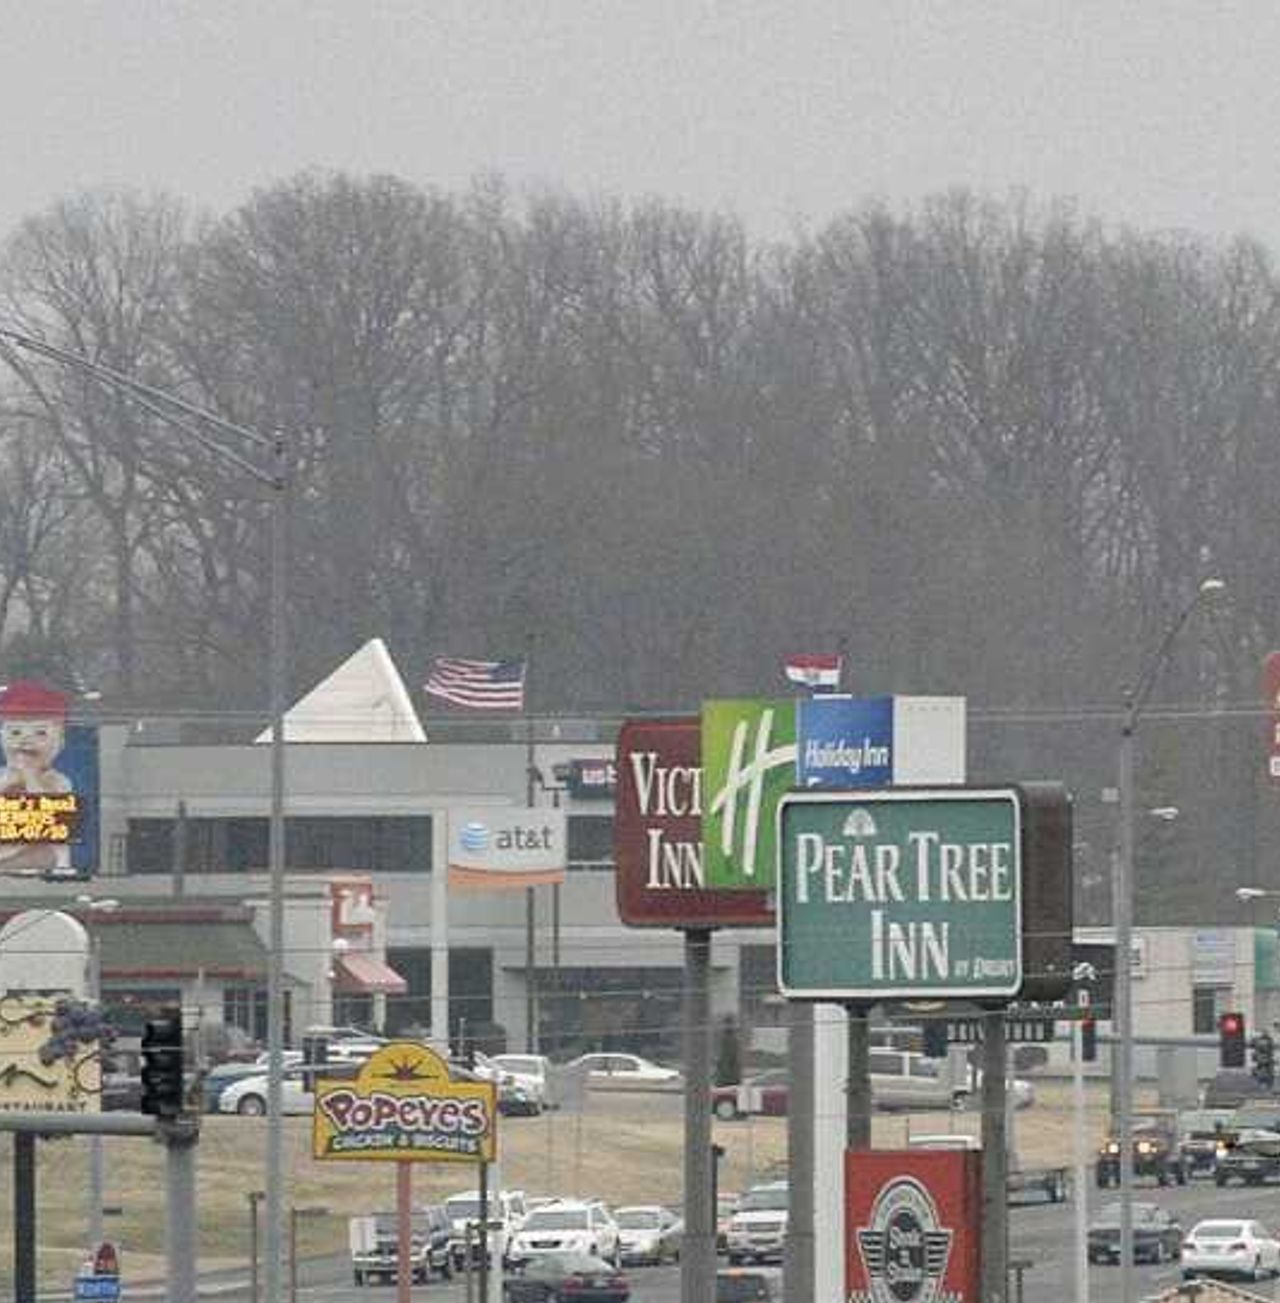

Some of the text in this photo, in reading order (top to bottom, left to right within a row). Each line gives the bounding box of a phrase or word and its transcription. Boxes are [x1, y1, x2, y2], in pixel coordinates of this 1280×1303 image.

[805, 738, 888, 774] Holiday Inn
[630, 752, 703, 817] VICT
[495, 826, 553, 850] at&t
